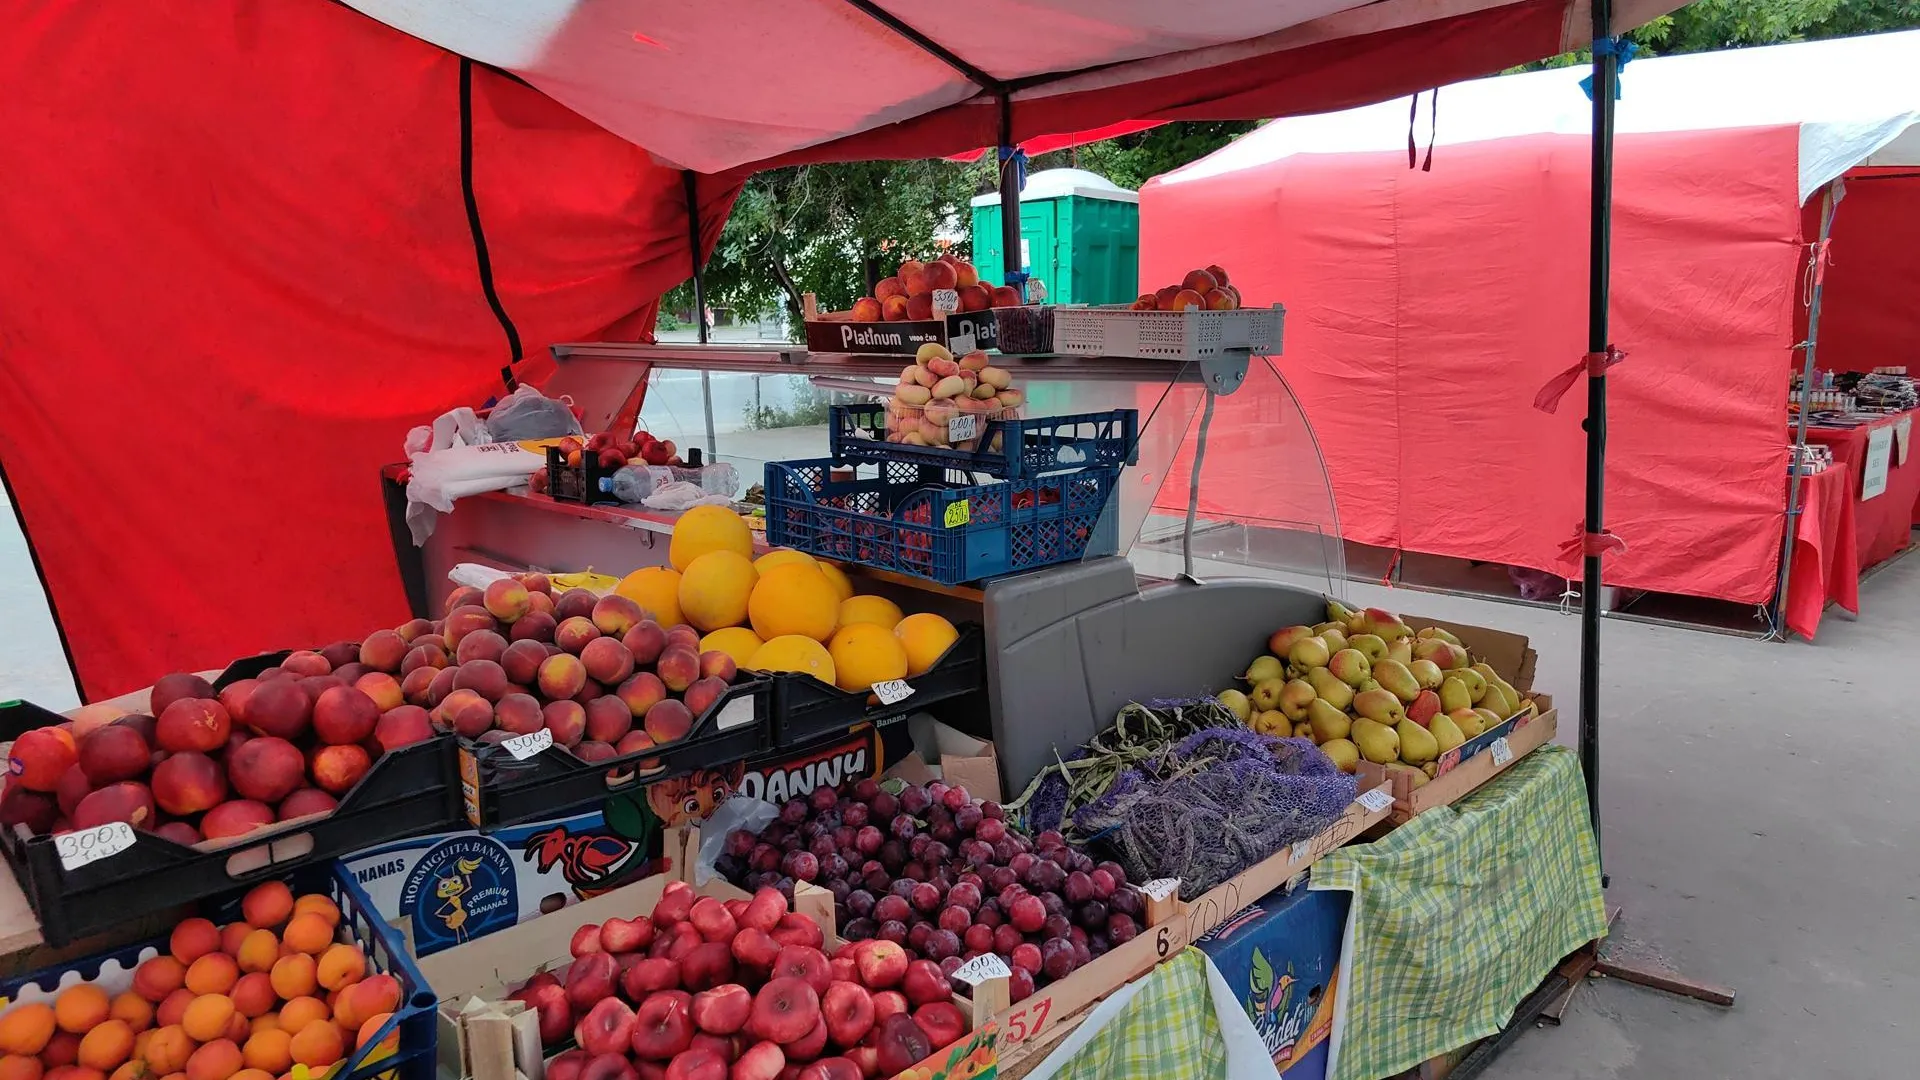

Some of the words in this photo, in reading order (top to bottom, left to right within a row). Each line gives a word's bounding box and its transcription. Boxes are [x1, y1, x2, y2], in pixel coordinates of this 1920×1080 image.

[841, 325, 902, 348] Platinum
[876, 714, 907, 729] Banana
[738, 748, 865, 804] DANNY
[352, 858, 405, 884] NANAS
[405, 842, 470, 904] HORMIGUITA
[473, 842, 510, 875] BANANA
[467, 886, 510, 908] PREMIUM
[470, 898, 509, 917] BANANAS
[1006, 997, 1052, 1044] 57
